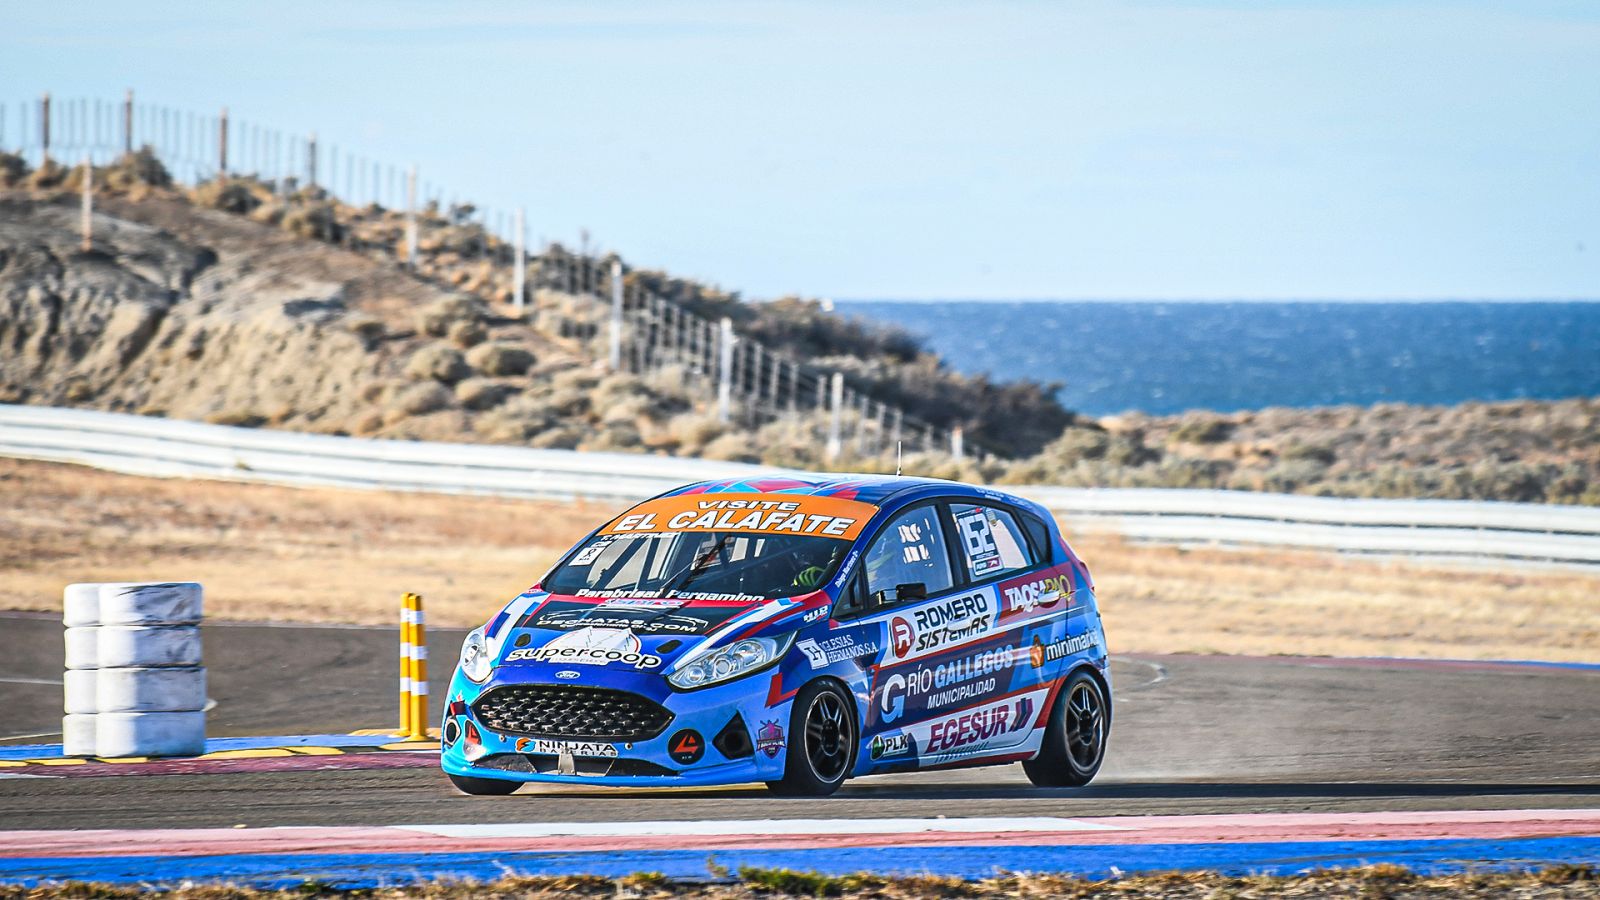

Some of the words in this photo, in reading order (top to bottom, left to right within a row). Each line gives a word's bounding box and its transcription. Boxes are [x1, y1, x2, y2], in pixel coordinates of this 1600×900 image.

[698, 500, 801, 511] VISITE
[611, 514, 658, 532] EL
[667, 510, 855, 535] CALAFATE
[914, 593, 988, 631] ROMERO
[819, 634, 854, 651] IGLESIAS
[916, 614, 990, 652] SISTEMAS
[510, 647, 660, 668] supercoop
[826, 644, 865, 663] HERMANOS
[907, 664, 932, 697] RÍO
[934, 644, 1014, 689] GALLEGOS
[927, 677, 996, 709] MUNICIPALIDAD
[925, 704, 1009, 754] EGESUR
[539, 741, 616, 751] NINJATA
[540, 748, 617, 757] BAERIAS
[885, 735, 909, 751] PLK
